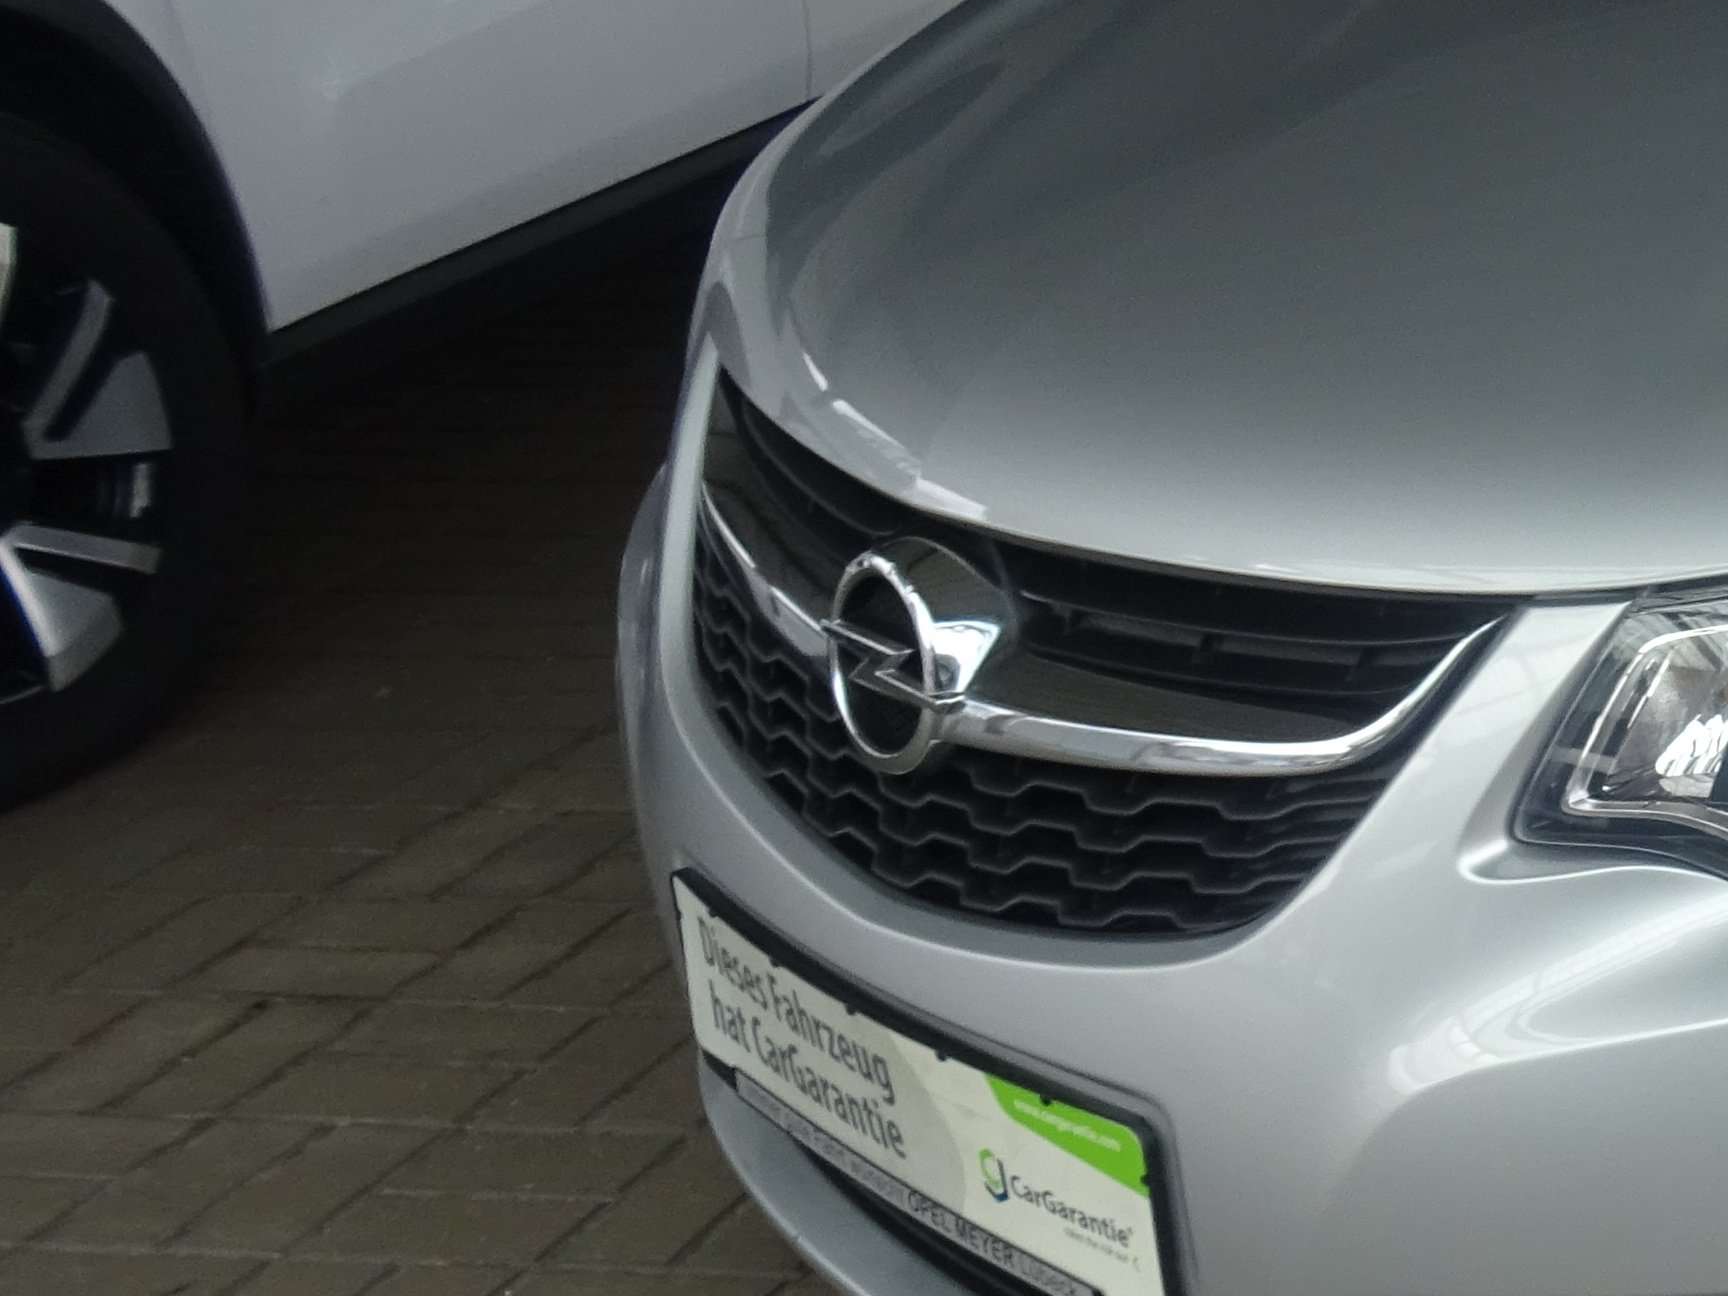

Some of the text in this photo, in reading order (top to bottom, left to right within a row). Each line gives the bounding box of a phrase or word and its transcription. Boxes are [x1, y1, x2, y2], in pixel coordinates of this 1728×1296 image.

[697, 916, 895, 1107] Dieses Fahrzeug
[709, 979, 752, 1053] hat
[752, 1016, 906, 1160] CarGarantie
[907, 1189, 952, 1233] OPEL
